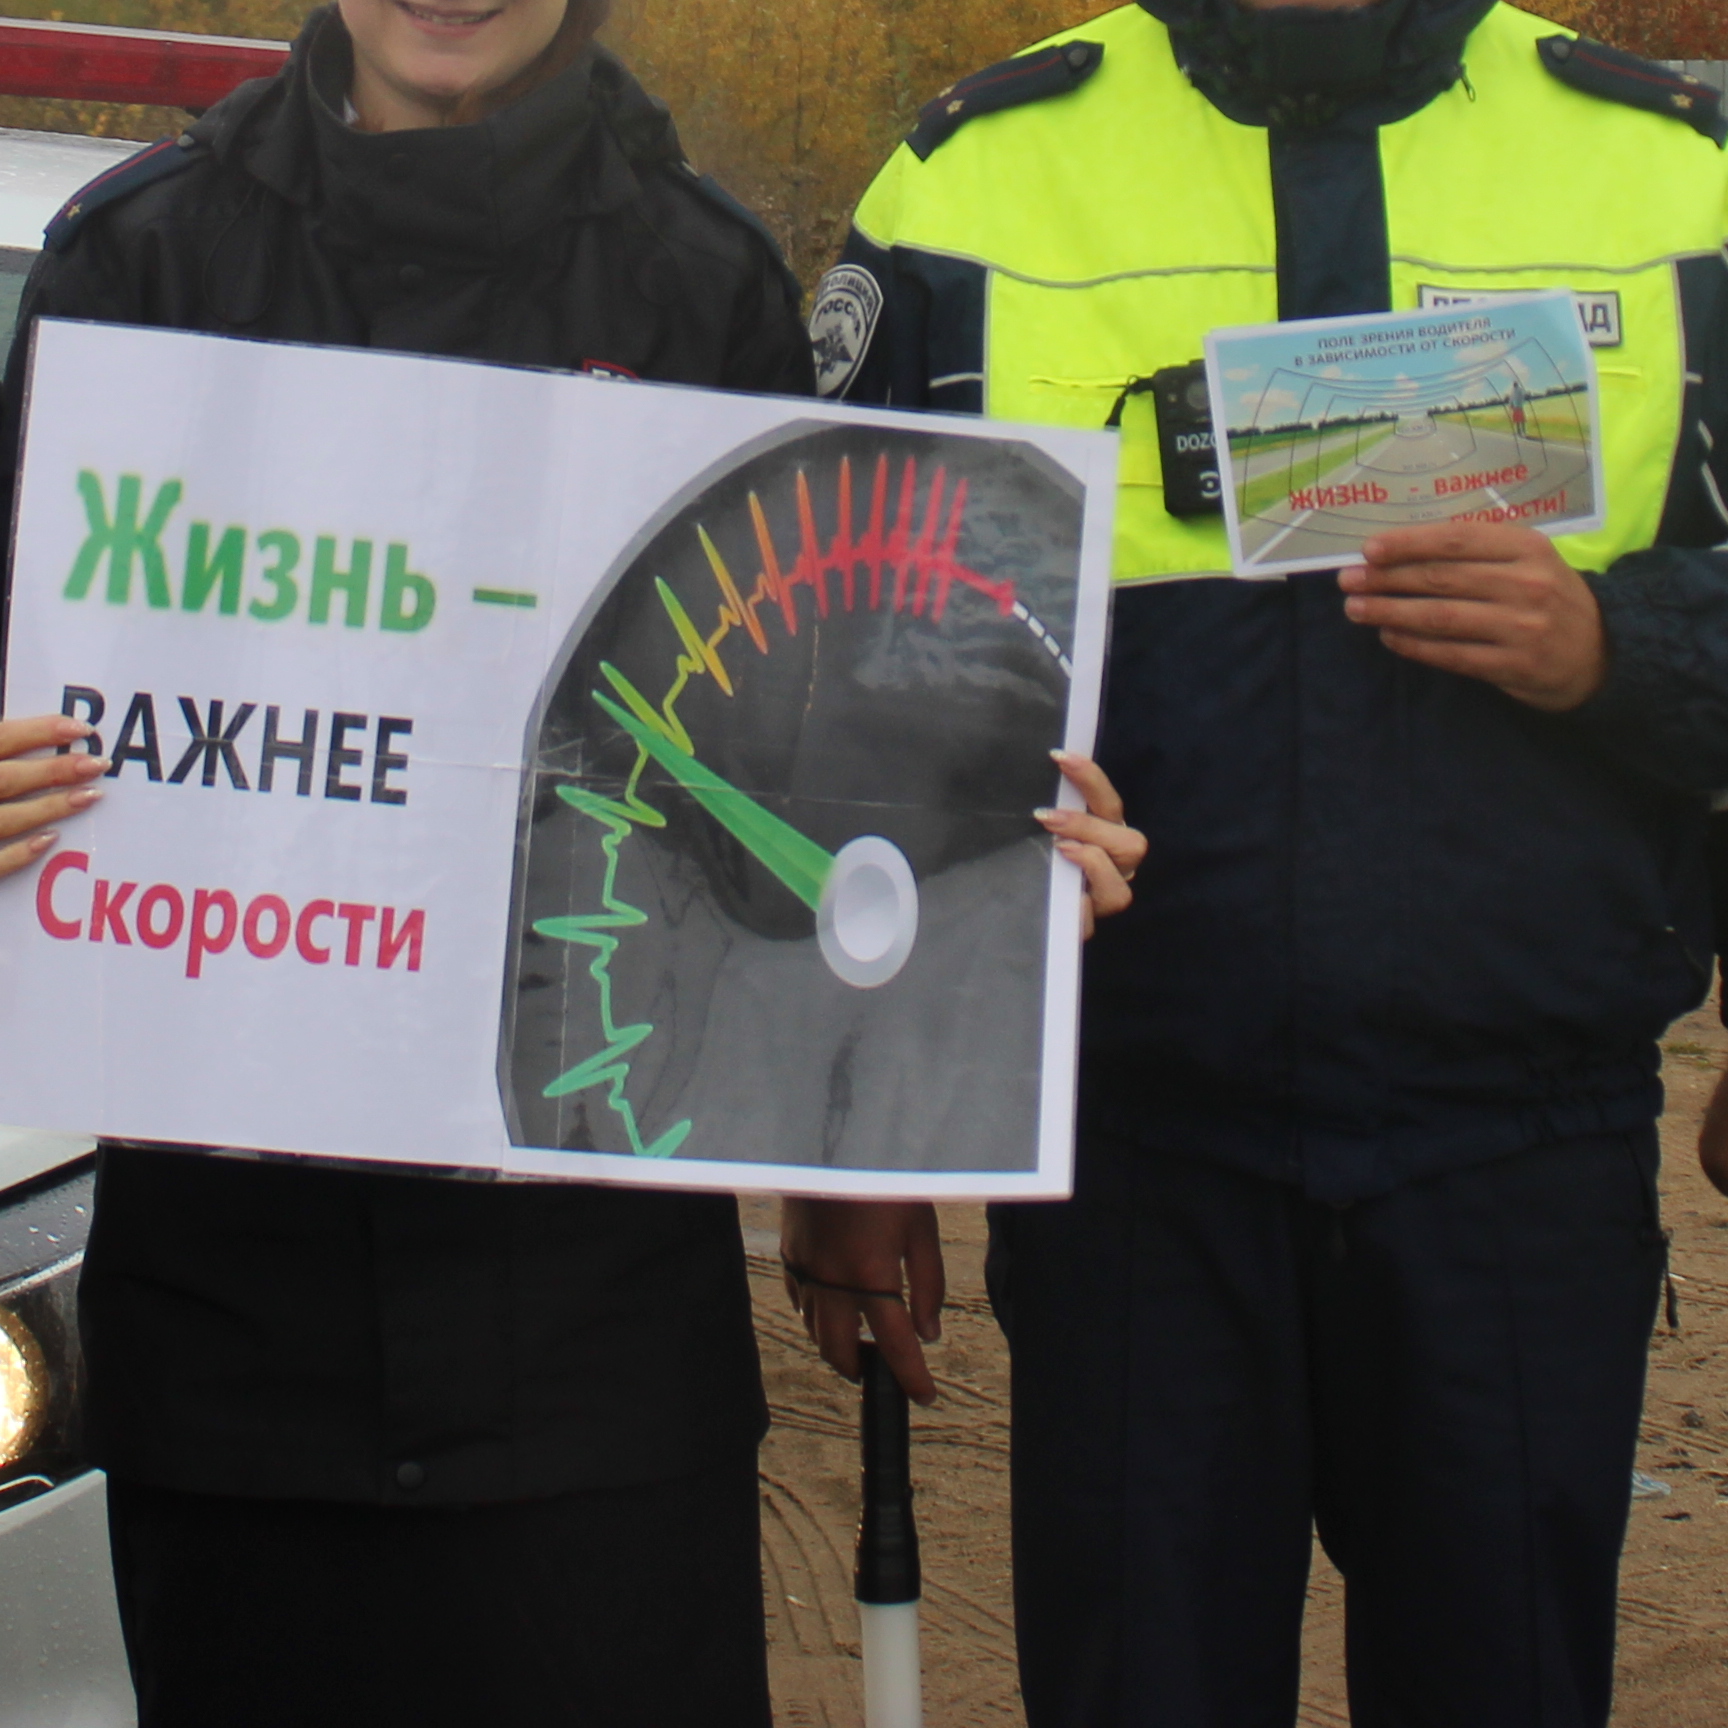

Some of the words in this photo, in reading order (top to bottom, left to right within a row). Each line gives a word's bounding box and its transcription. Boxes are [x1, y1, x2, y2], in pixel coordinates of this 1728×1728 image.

[1294, 356, 1303, 367] В
[1308, 343, 1416, 366] ЗАВИСИМОСТИ
[1420, 339, 1438, 352] ОТ
[1443, 328, 1516, 349] СКОРОСТИ
[1318, 335, 1355, 349] ПОЛЕ
[1361, 328, 1414, 344] ЗРЕНИЯ
[1418, 318, 1491, 338] ВОДИТЕЛЯ
[1289, 481, 1389, 511] ЖИЗНЬ
[1433, 463, 1528, 496] важнее
[62, 468, 436, 634] Жизнь
[57, 684, 413, 805] ВАЖНЕЕ
[34, 850, 427, 979] Скорости
